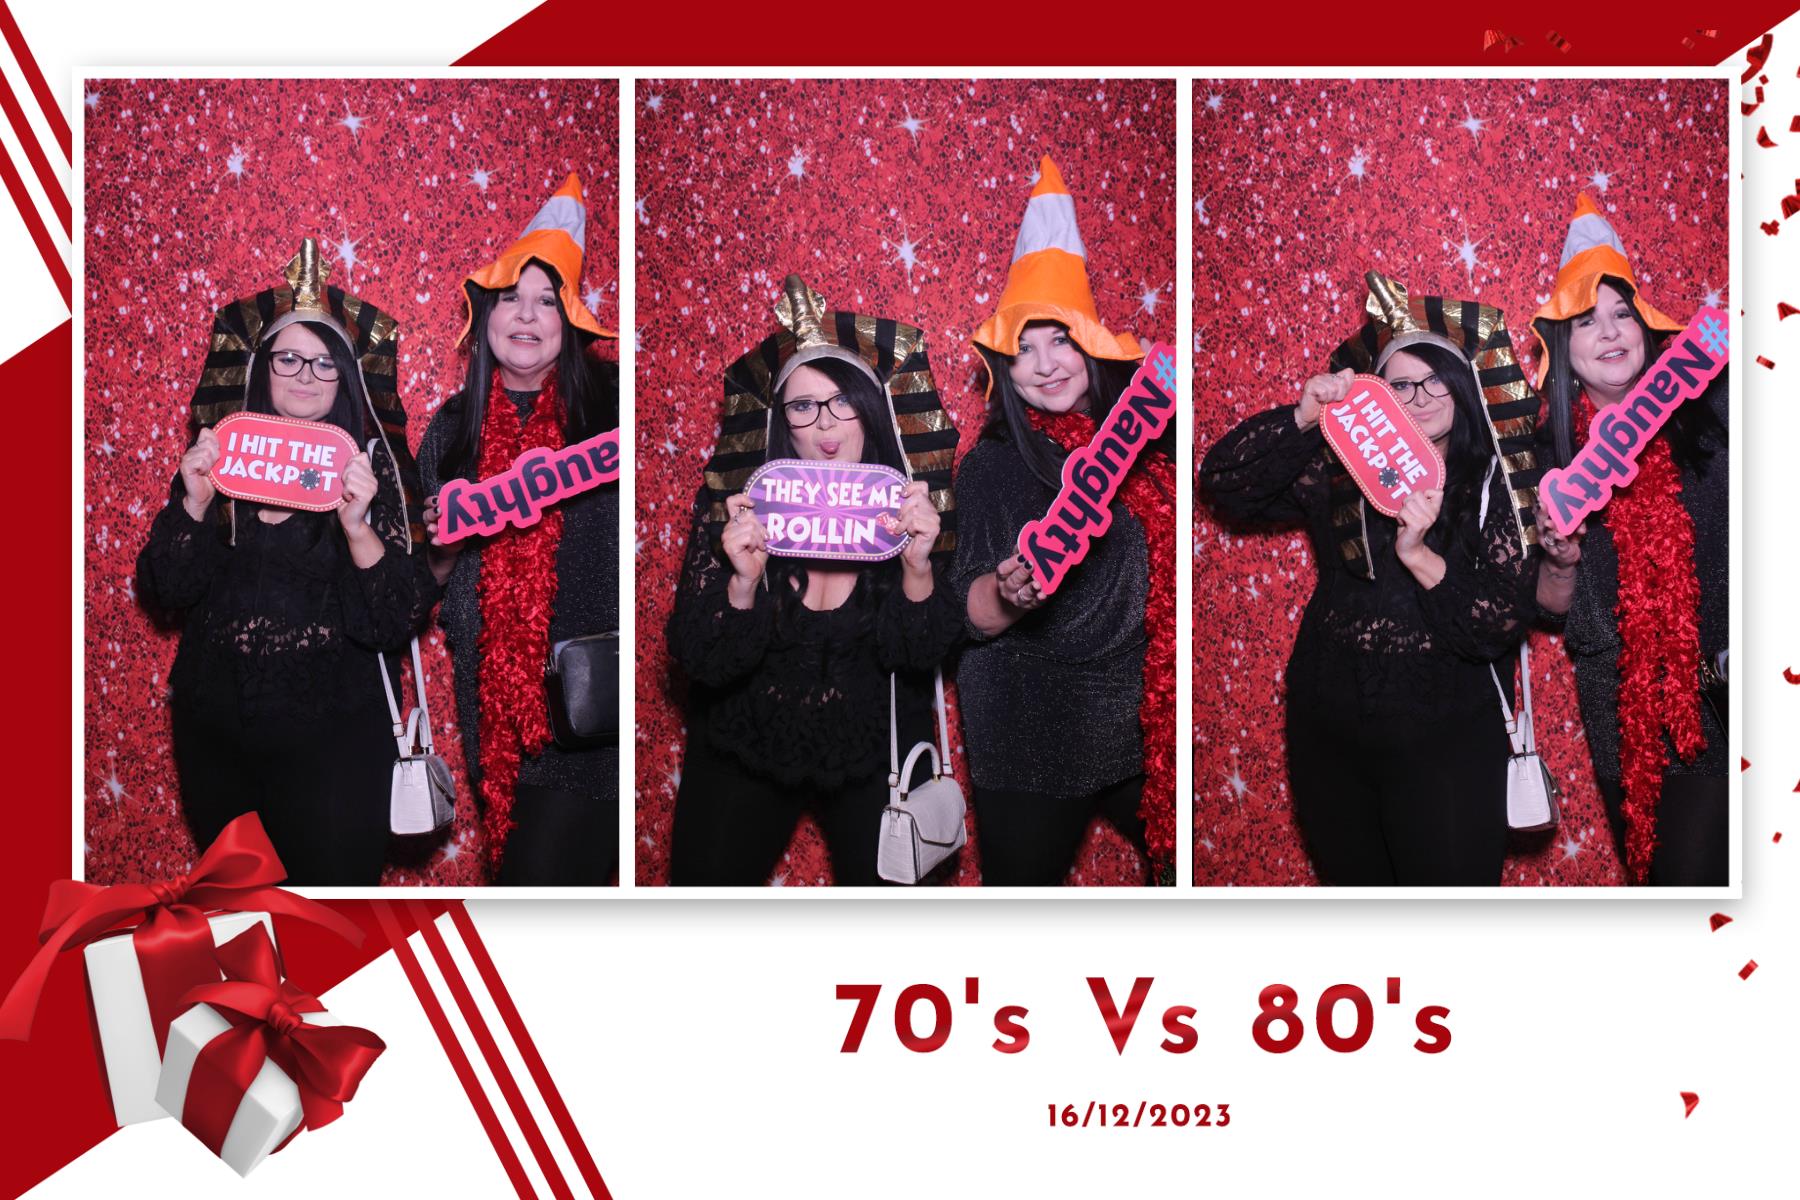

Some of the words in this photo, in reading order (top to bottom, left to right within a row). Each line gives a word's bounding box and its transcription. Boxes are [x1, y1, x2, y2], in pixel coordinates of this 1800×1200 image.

[1352, 390, 1370, 405] I
[1360, 400, 1397, 438] HIT
[1548, 315, 1729, 525] #Naughty
[228, 432, 238, 451] I
[241, 434, 283, 458] HIT
[288, 441, 337, 467] THE
[1388, 437, 1428, 485] THE
[762, 478, 822, 505] THEY
[827, 482, 864, 507] SEE
[867, 485, 902, 509] ME
[767, 512, 876, 545] ROLLIN
